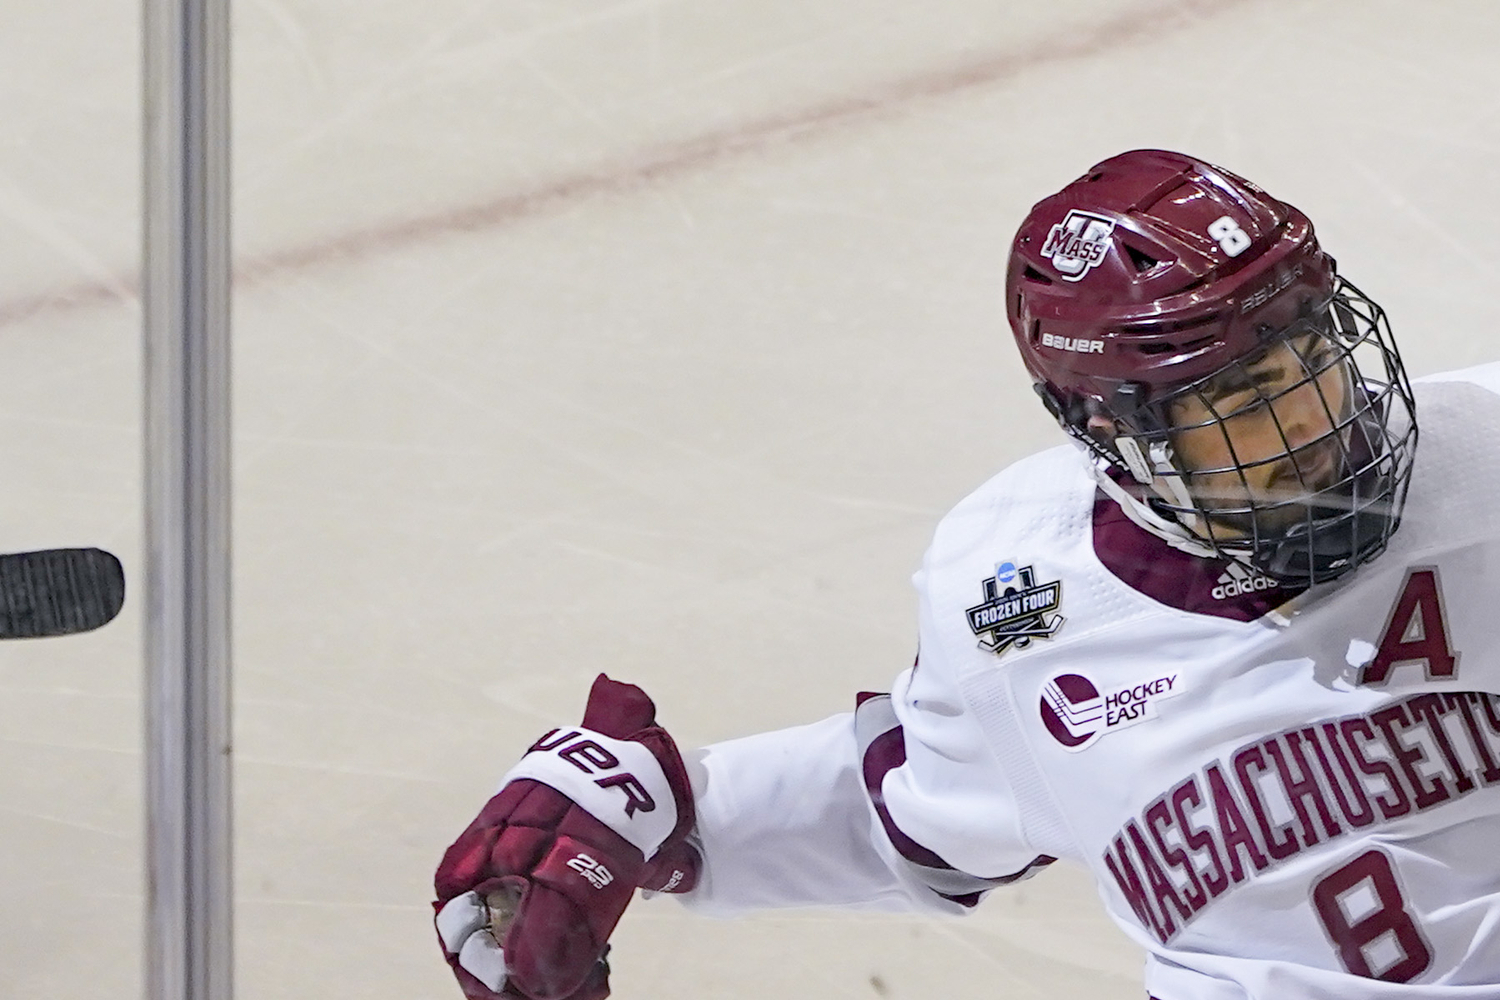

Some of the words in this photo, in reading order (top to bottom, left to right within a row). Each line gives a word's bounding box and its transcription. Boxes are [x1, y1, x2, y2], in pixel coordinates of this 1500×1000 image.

[1207, 215, 1252, 258] 8
[973, 599, 1021, 629] FROZEN
[1022, 588, 1056, 613] FOUR
[1211, 575, 1280, 600] adidas
[1361, 565, 1462, 687] A
[1105, 673, 1178, 710] HOCKEY
[1106, 700, 1148, 727] EAST
[521, 727, 656, 820] UER
[1308, 845, 1435, 985] 8
